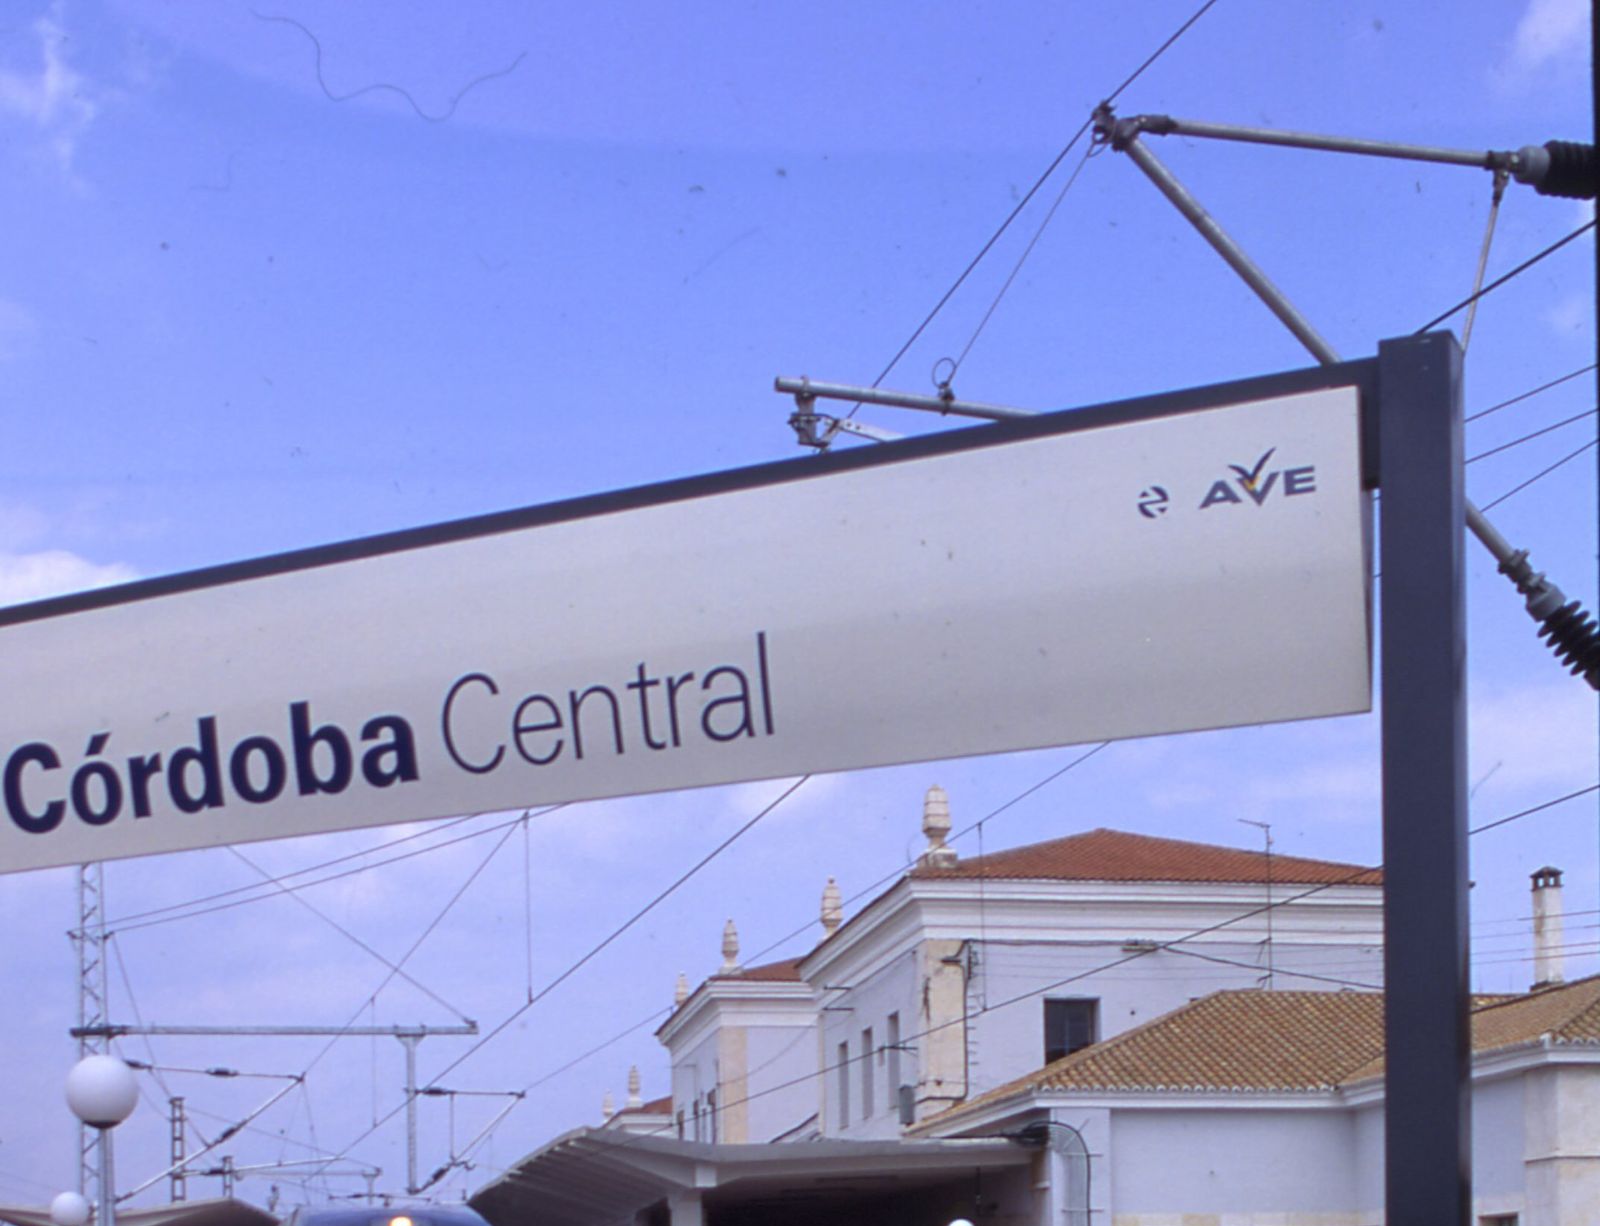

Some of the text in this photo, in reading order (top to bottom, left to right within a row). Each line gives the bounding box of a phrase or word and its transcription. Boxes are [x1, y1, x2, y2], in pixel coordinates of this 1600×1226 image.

[1199, 447, 1317, 509] AVE
[3, 631, 775, 834] Córdoba Central
